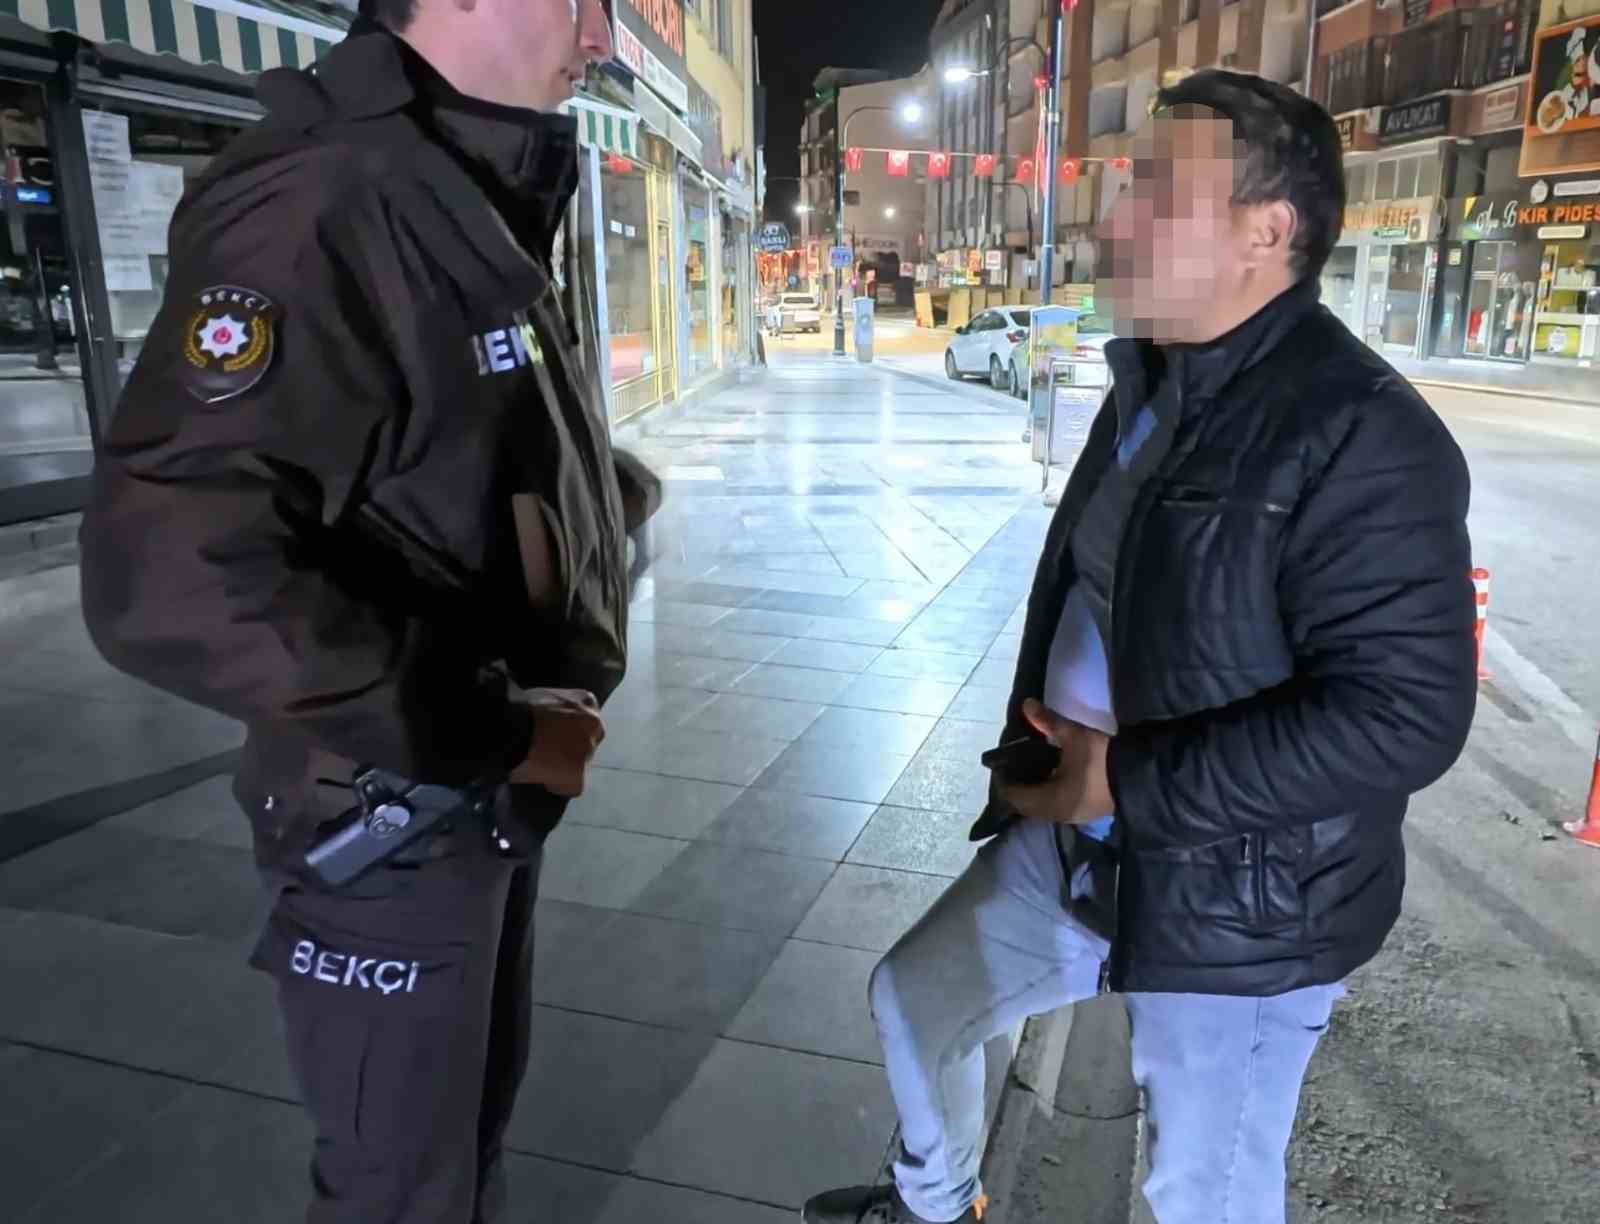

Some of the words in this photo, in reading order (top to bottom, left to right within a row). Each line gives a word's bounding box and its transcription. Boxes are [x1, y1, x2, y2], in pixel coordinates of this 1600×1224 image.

[1385, 101, 1441, 132] AVUKAT
[1519, 207, 1548, 224] KIR
[291, 940, 420, 995] BEKÇİ
